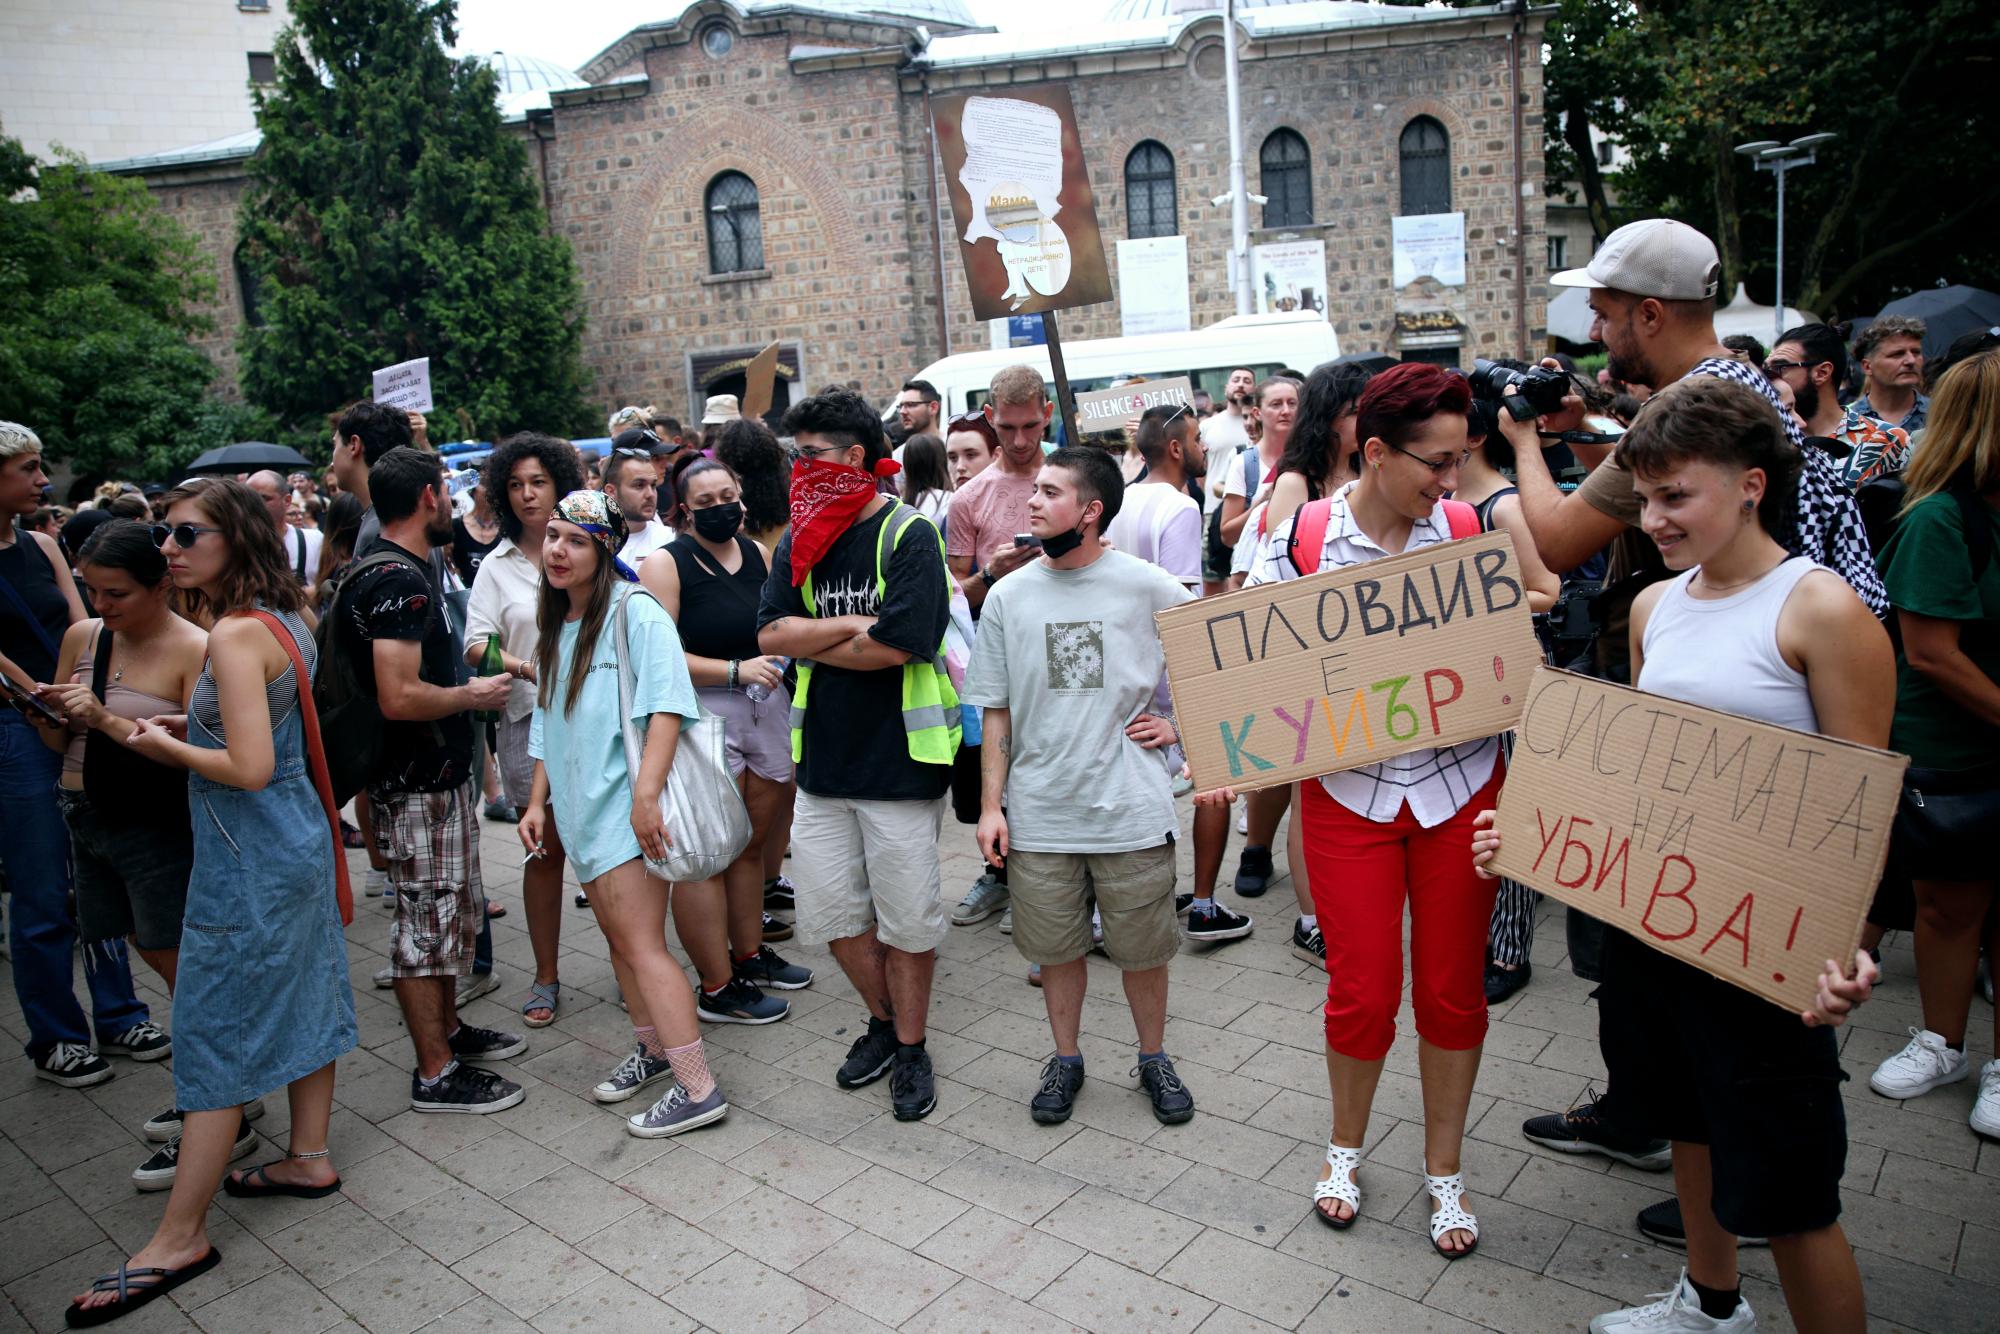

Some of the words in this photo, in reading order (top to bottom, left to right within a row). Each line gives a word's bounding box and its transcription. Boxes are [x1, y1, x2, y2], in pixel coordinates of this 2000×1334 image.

[381, 378, 421, 395] ЗАСЛУЖАВАТ
[1083, 395, 1134, 419] SILENCE
[1206, 548, 1522, 670] ПЛОВДИВ
[1321, 653, 1354, 695] Е
[1525, 680, 1873, 860] СИСТЕМАТА
[1629, 796, 1694, 857] НИ
